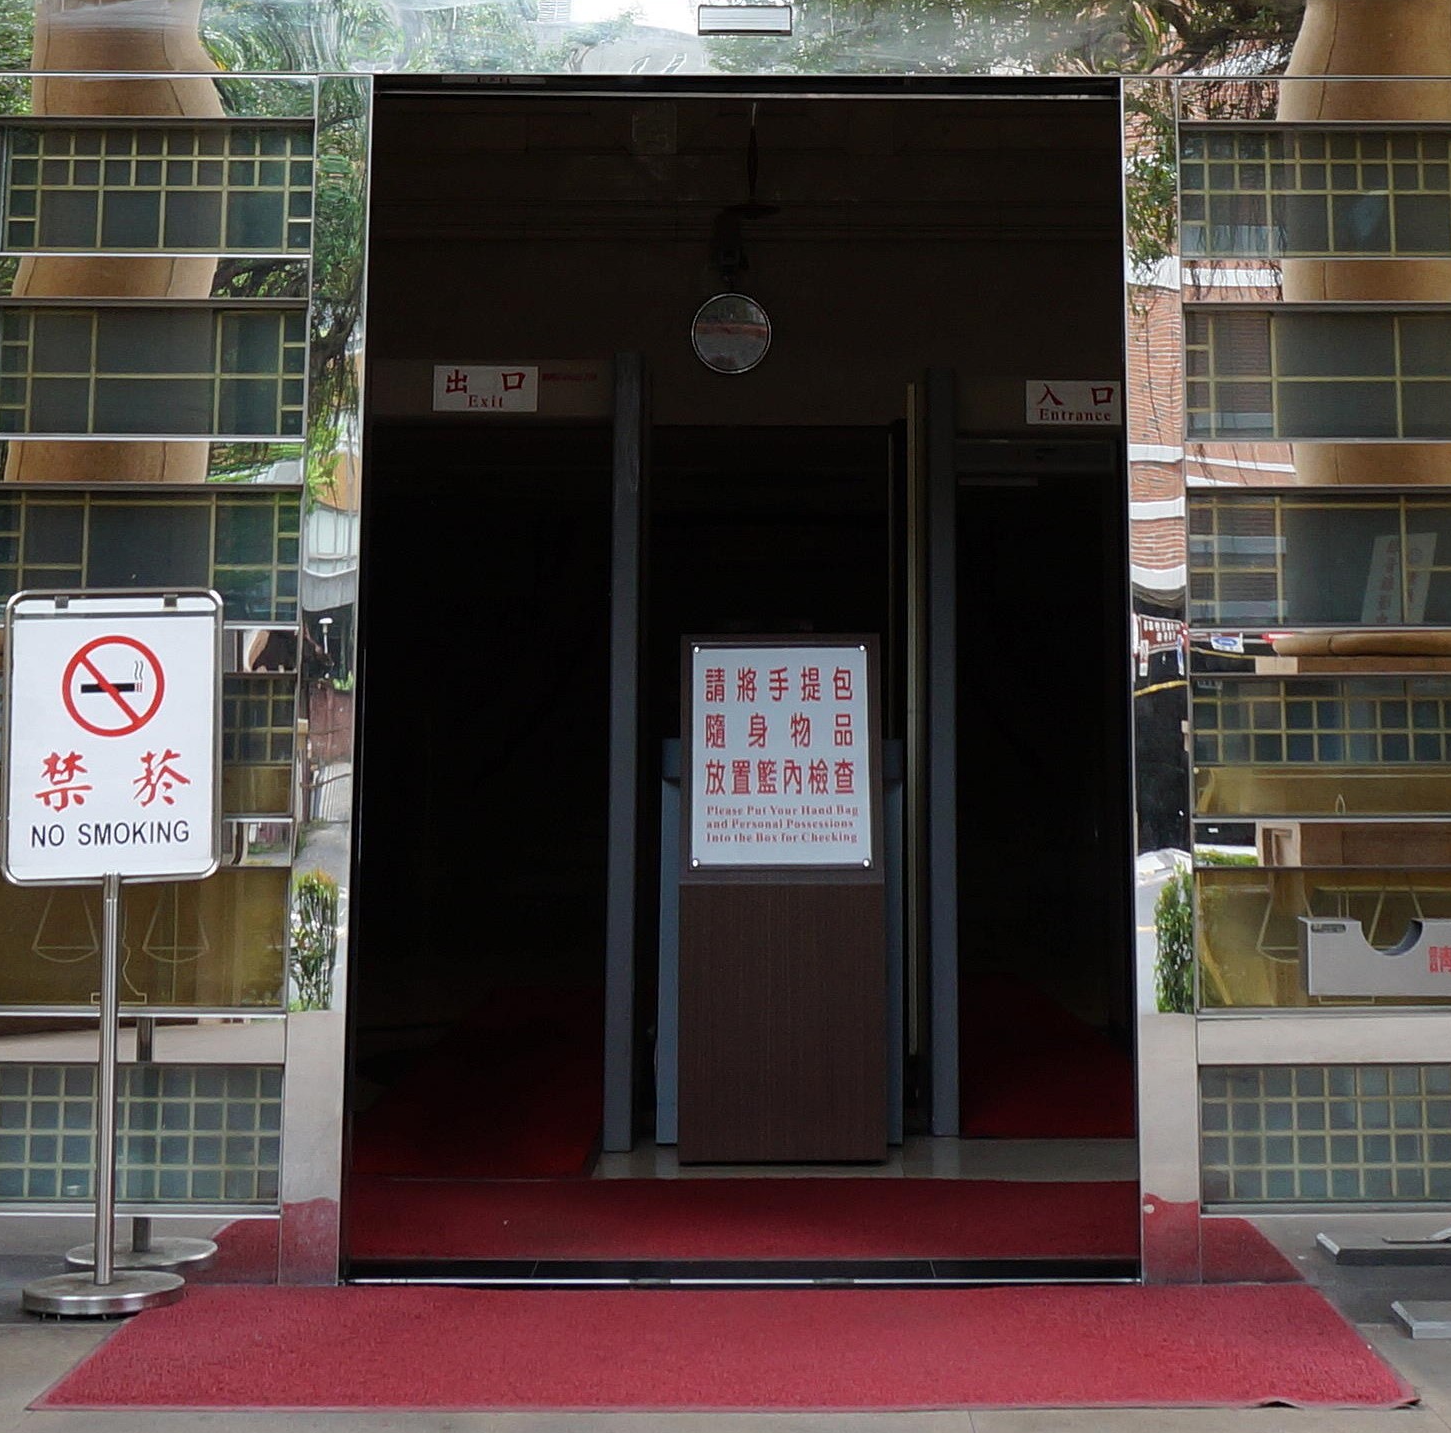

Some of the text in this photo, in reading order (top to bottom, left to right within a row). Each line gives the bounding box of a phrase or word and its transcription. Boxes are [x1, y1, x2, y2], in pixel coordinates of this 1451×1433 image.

[446, 369, 526, 394] 出口
[468, 395, 503, 409] Exit
[1037, 383, 1114, 406] 入口
[1039, 409, 1111, 421] Entrance
[705, 667, 853, 703] 請將手提包
[705, 712, 853, 748] 隨身物品
[35, 748, 191, 812] 禁菸
[706, 804, 859, 817] Please Put Your Hand Bag
[31, 820, 190, 848] NO SMOKING
[706, 819, 854, 829] and Personal Possessions
[706, 833, 858, 844] Into the Box for Checking
